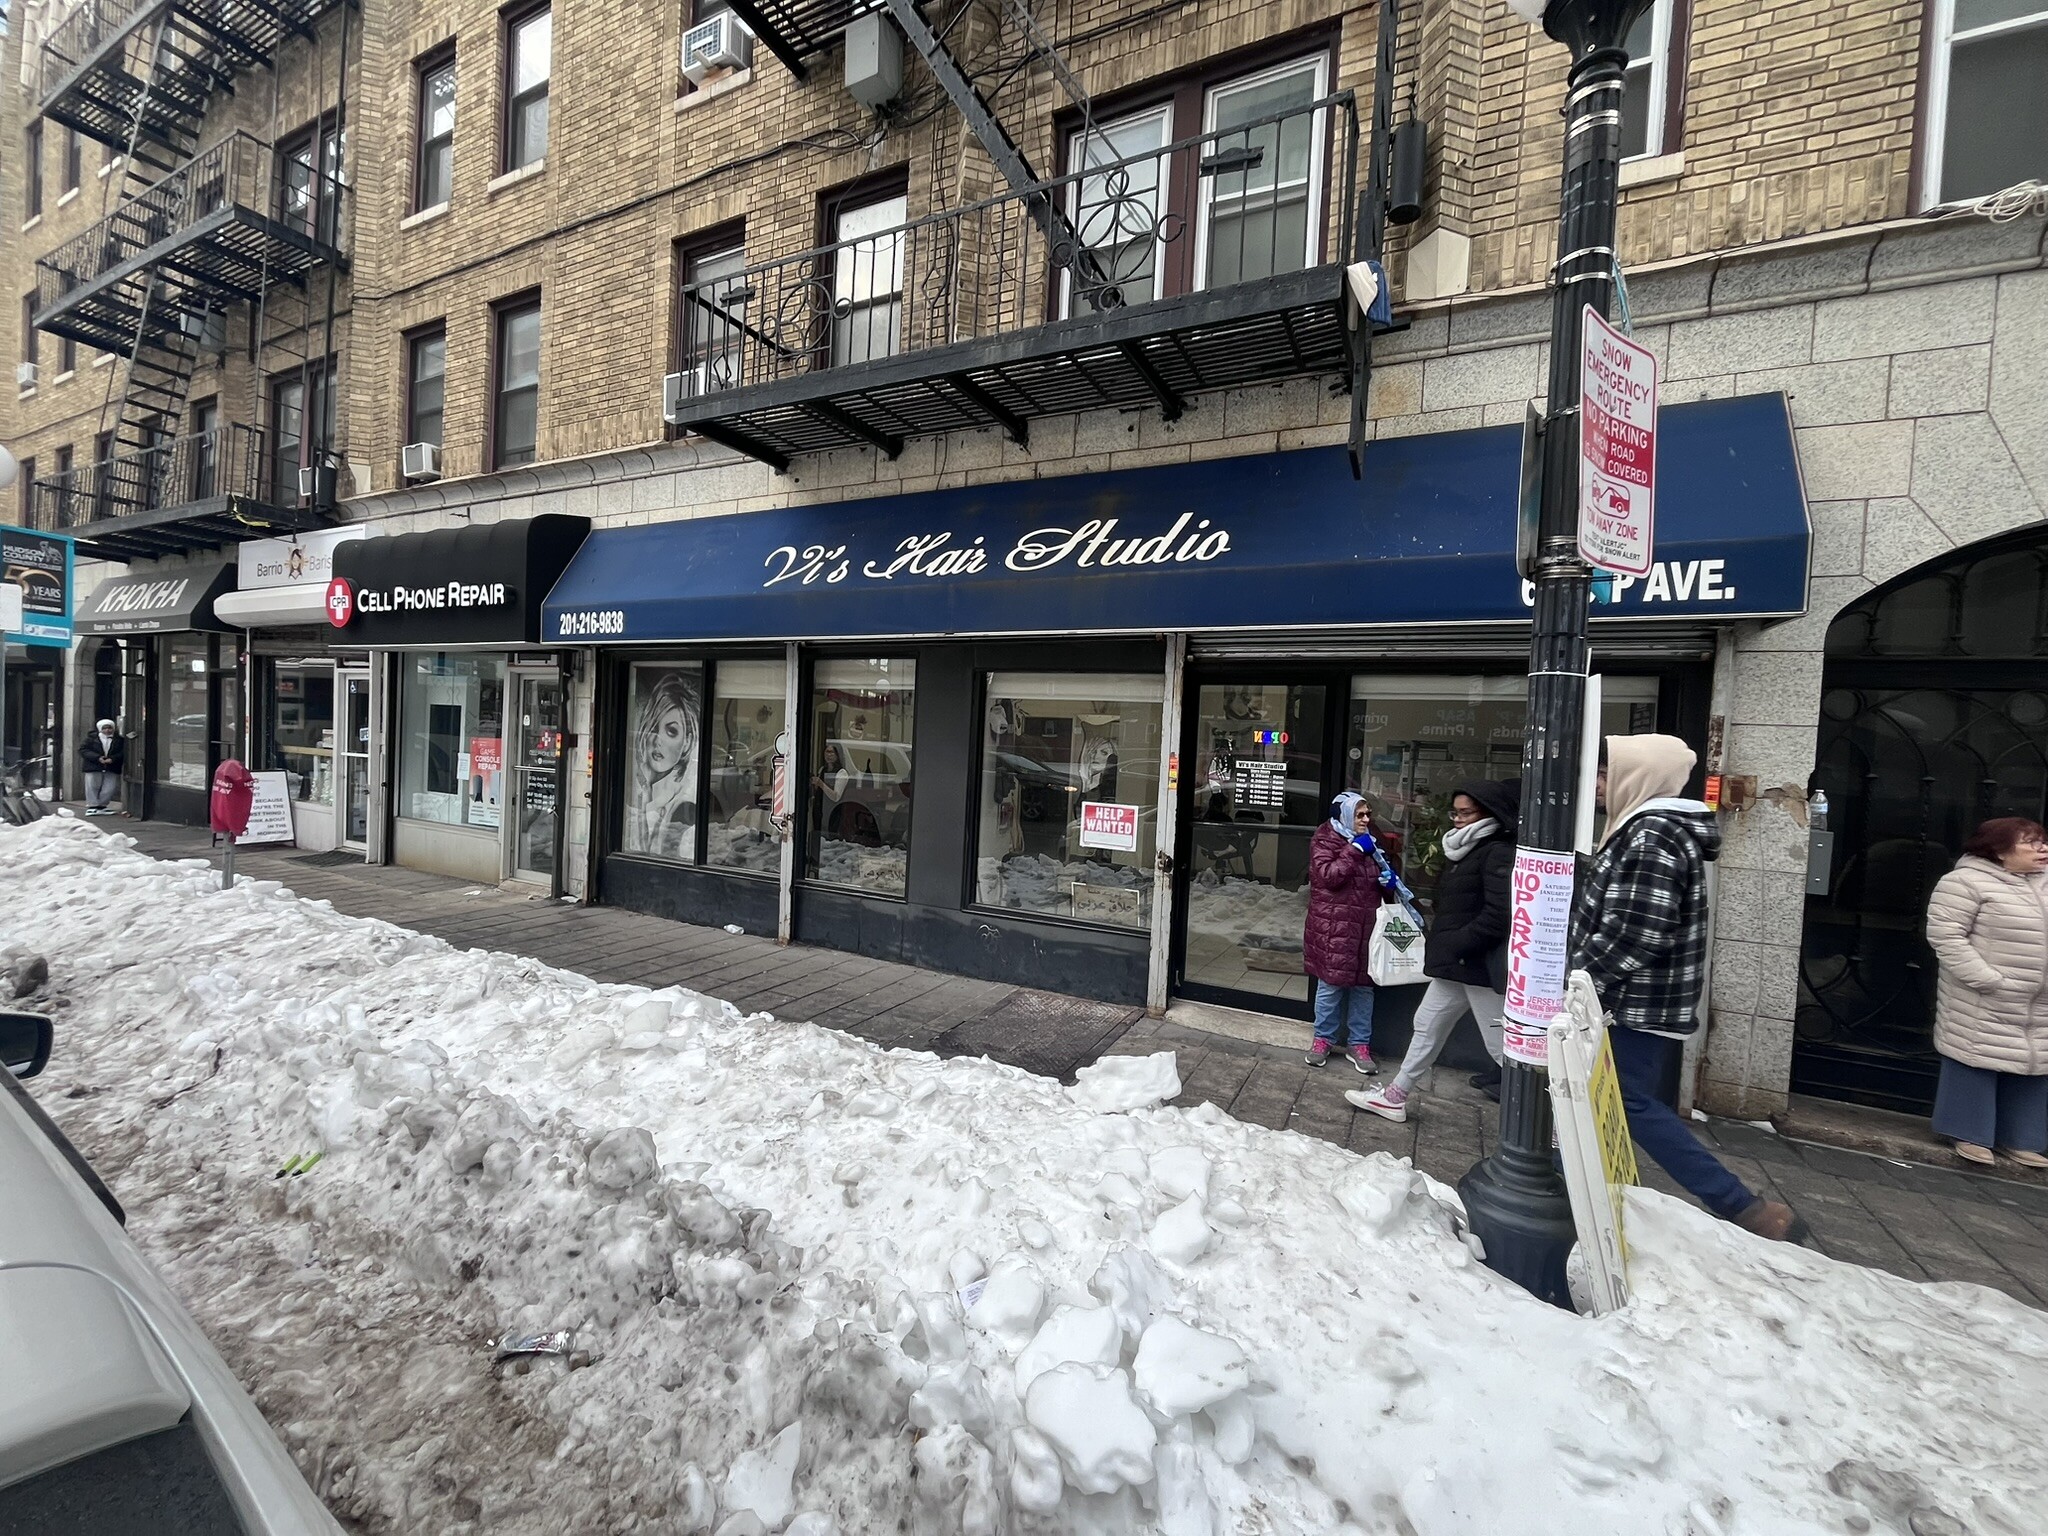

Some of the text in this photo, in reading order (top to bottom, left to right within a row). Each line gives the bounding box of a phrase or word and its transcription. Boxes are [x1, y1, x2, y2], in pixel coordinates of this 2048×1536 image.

[1602, 338, 1632, 372] SNOW
[1588, 349, 1650, 404] EMERGENCY
[1597, 384, 1632, 419] ROUTE
[1586, 398, 1648, 449] NO PARKING
[1611, 442, 1634, 462] ROAD
[1608, 460, 1648, 484] COVERED
[1616, 522, 1638, 540] ZONE
[2, 544, 45, 558] HUDSON
[2, 550, 44, 562] COUNTY
[764, 512, 1231, 588] Vi's Hair Studio
[1604, 547, 1622, 557] SNOW
[1622, 551, 1640, 561] ALERT
[257, 554, 332, 577] Barrio Baris
[1642, 558, 1736, 602] AVE.
[32, 585, 62, 598] YEARS
[94, 578, 189, 612] KHOKHA
[358, 582, 505, 612] CELL PHONE REPAIR
[560, 610, 624, 634] 201-216-9838
[474, 756, 500, 764] CONSOLE
[1096, 806, 1124, 820] HELP
[1086, 818, 1132, 834] WANTED
[1516, 856, 1574, 876] EMERGENC
[1514, 871, 1540, 891] NO
[1506, 890, 1534, 1006] PARKING
[1527, 996, 1555, 1006] JERSEY
